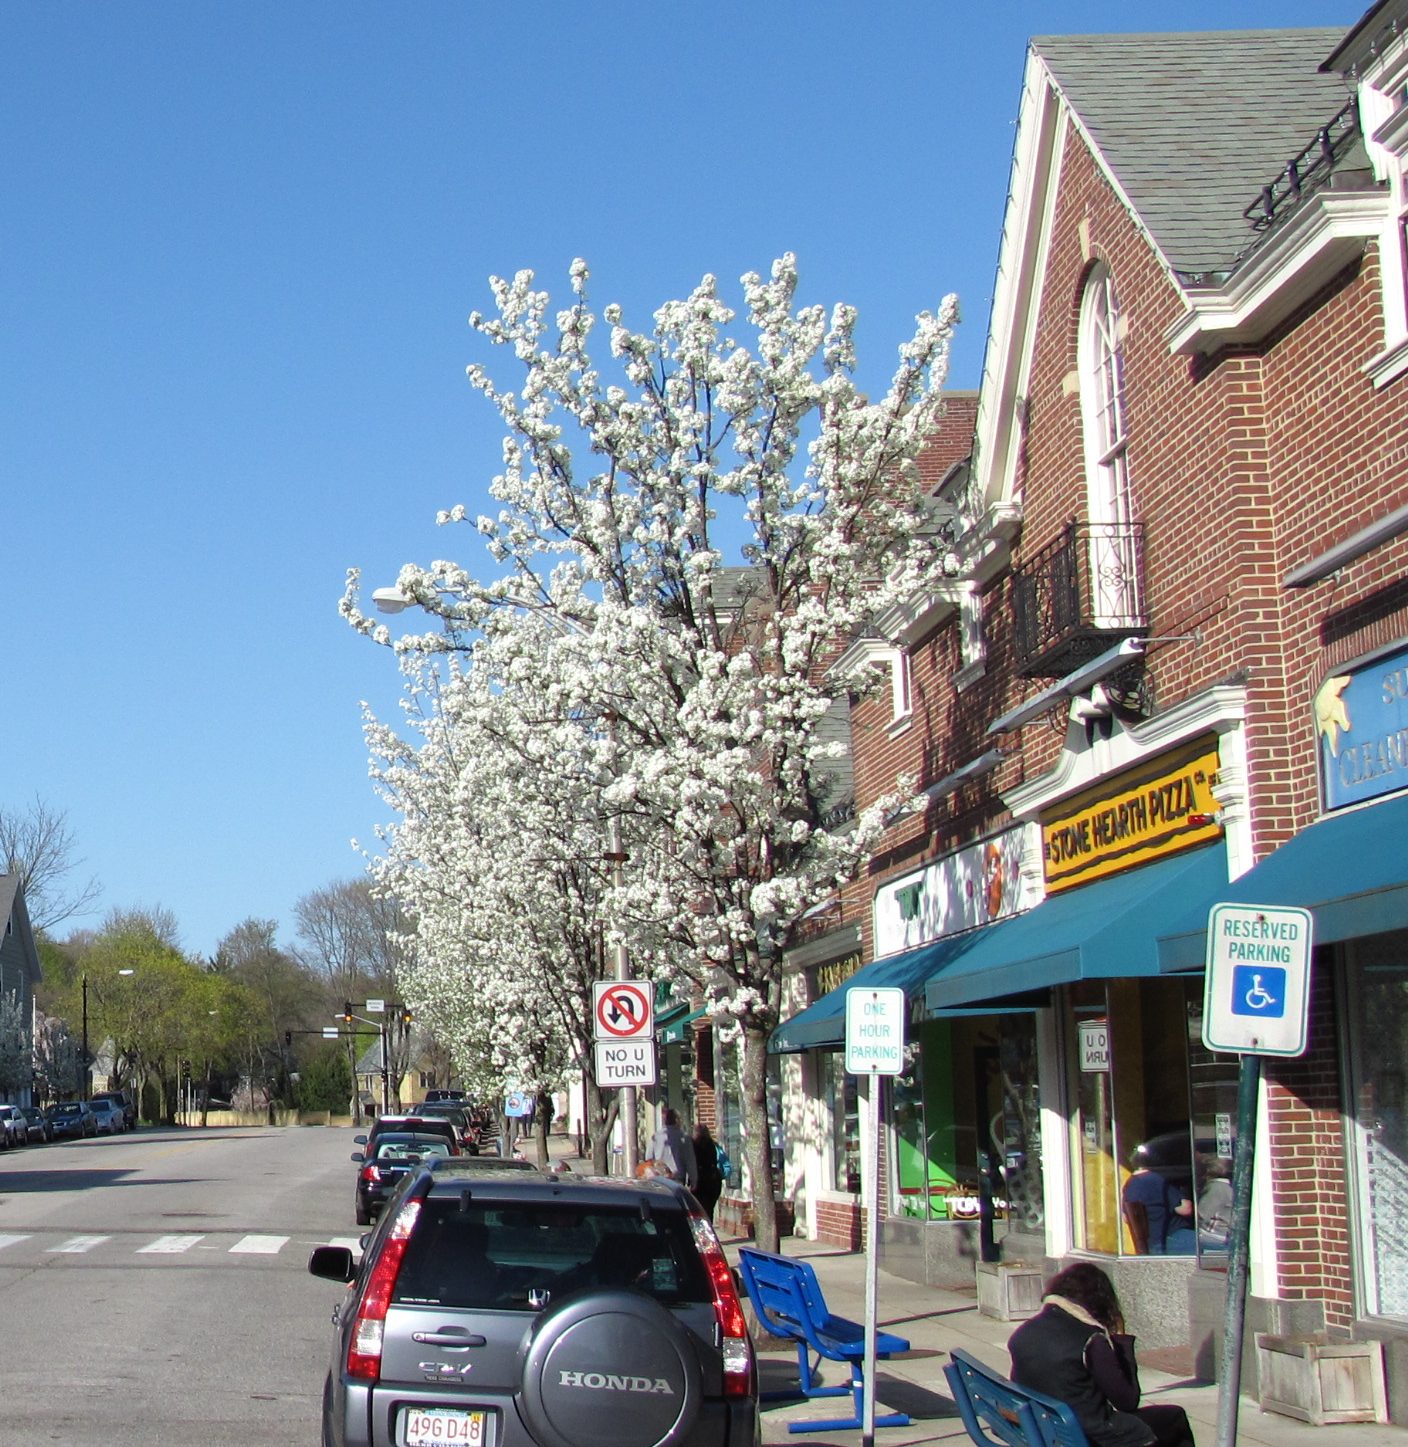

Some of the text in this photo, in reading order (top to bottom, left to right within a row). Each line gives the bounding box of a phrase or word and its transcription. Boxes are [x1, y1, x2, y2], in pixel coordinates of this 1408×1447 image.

[1051, 818, 1091, 865] STONE
[1092, 794, 1147, 848] HEARTH
[1148, 775, 1197, 827] PIZZA
[1224, 919, 1298, 941] RESERVED
[1228, 942, 1291, 963] PARKING
[863, 1002, 887, 1016] ONE
[859, 1024, 890, 1038] HOUR
[605, 1048, 644, 1062] NO U
[851, 1046, 898, 1060] PARKING
[605, 1064, 646, 1078] TURN
[559, 1370, 674, 1395] HONDA
[447, 1418, 480, 1440] D48
